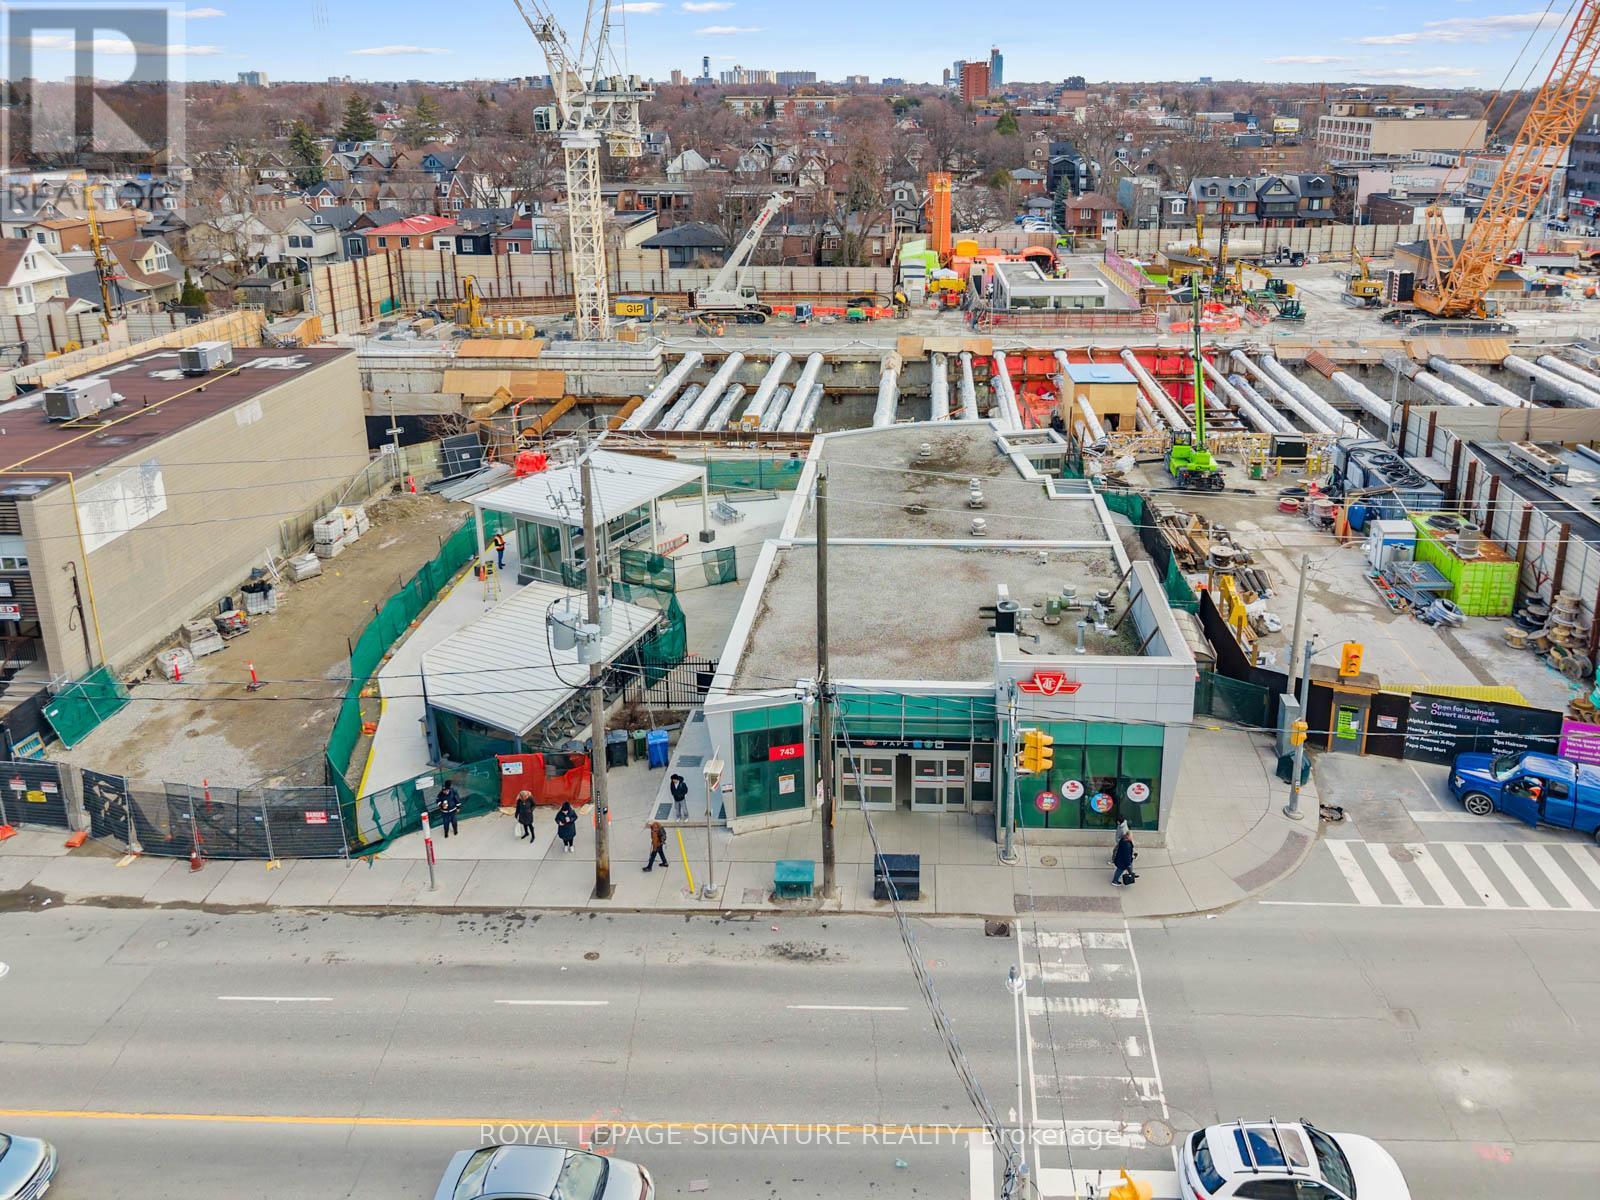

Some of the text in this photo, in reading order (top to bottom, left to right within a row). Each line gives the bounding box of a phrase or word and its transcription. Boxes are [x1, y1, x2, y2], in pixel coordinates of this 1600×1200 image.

[626, 304, 643, 312] GIP
[1431, 702, 1452, 712] Open
[1464, 707, 1495, 716] business
[1431, 709, 1456, 718] Ouvert
[1472, 714, 1499, 723] affaires
[1425, 720, 1457, 729] Laboratories
[1407, 726, 1428, 734] Hearing
[779, 748, 795, 756] 743
